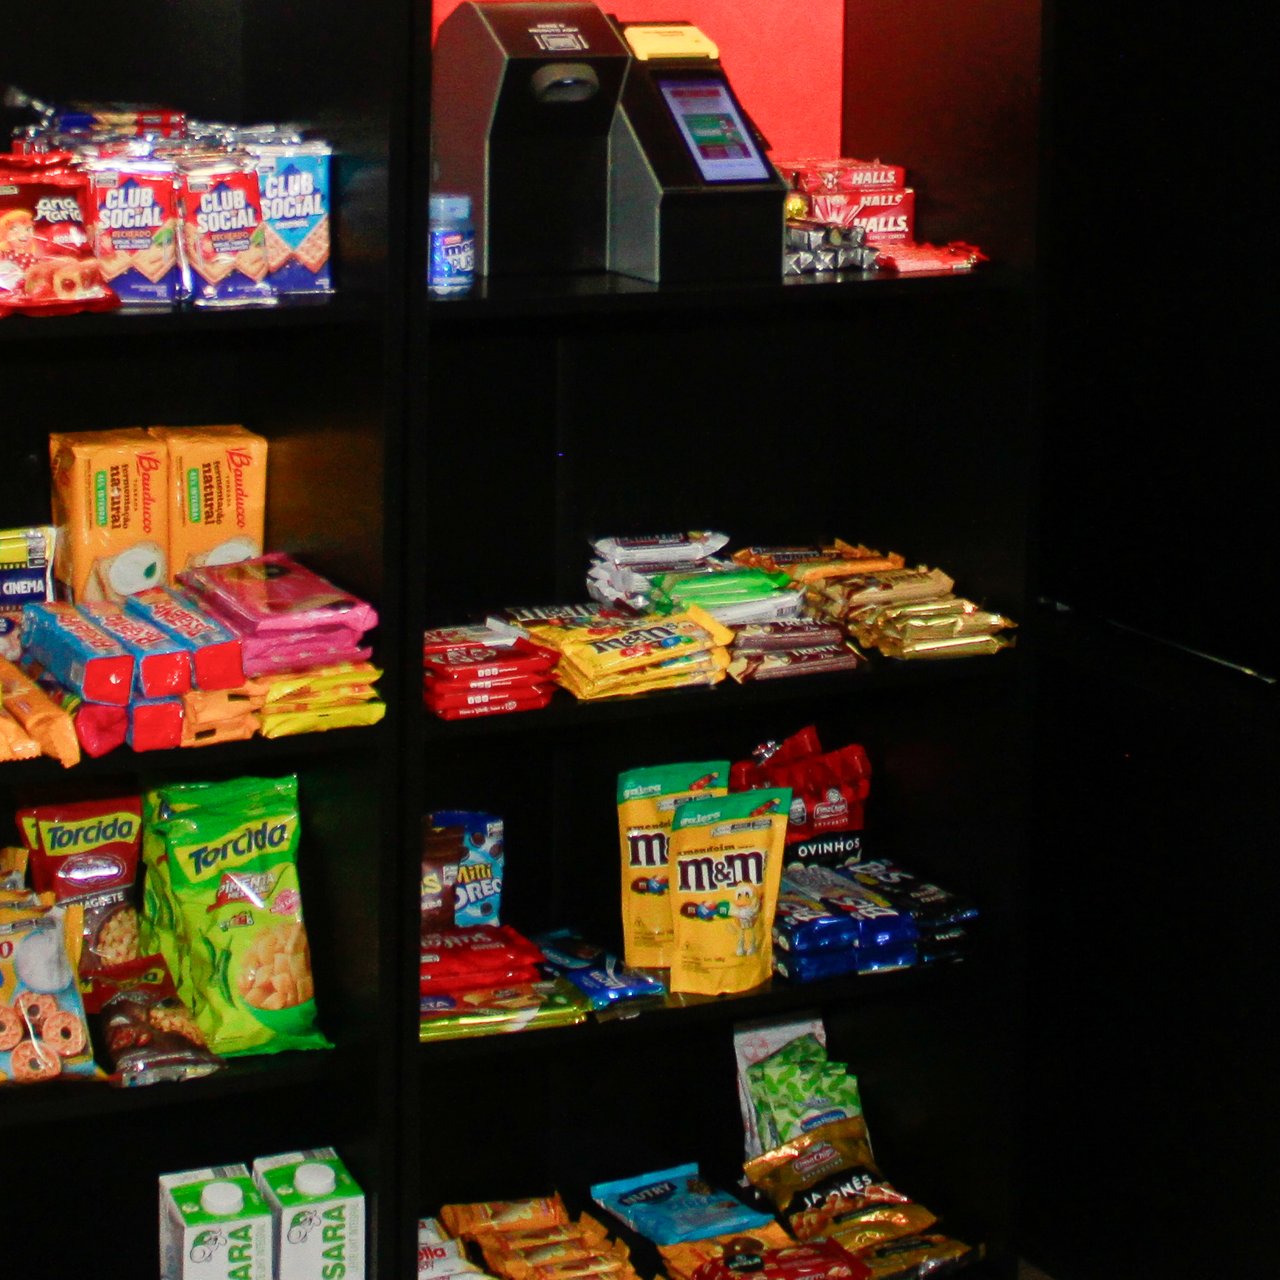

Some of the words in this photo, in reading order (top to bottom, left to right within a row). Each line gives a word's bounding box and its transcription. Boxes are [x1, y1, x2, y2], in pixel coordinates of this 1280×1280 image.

[264, 171, 315, 198] CLUB
[104, 187, 153, 210] CLUB
[199, 190, 247, 213] CLUB
[135, 450, 162, 535] Bauducco
[202, 462, 216, 526] natural
[226, 446, 253, 530] Bauducco
[4, 579, 45, 596] CINEMA
